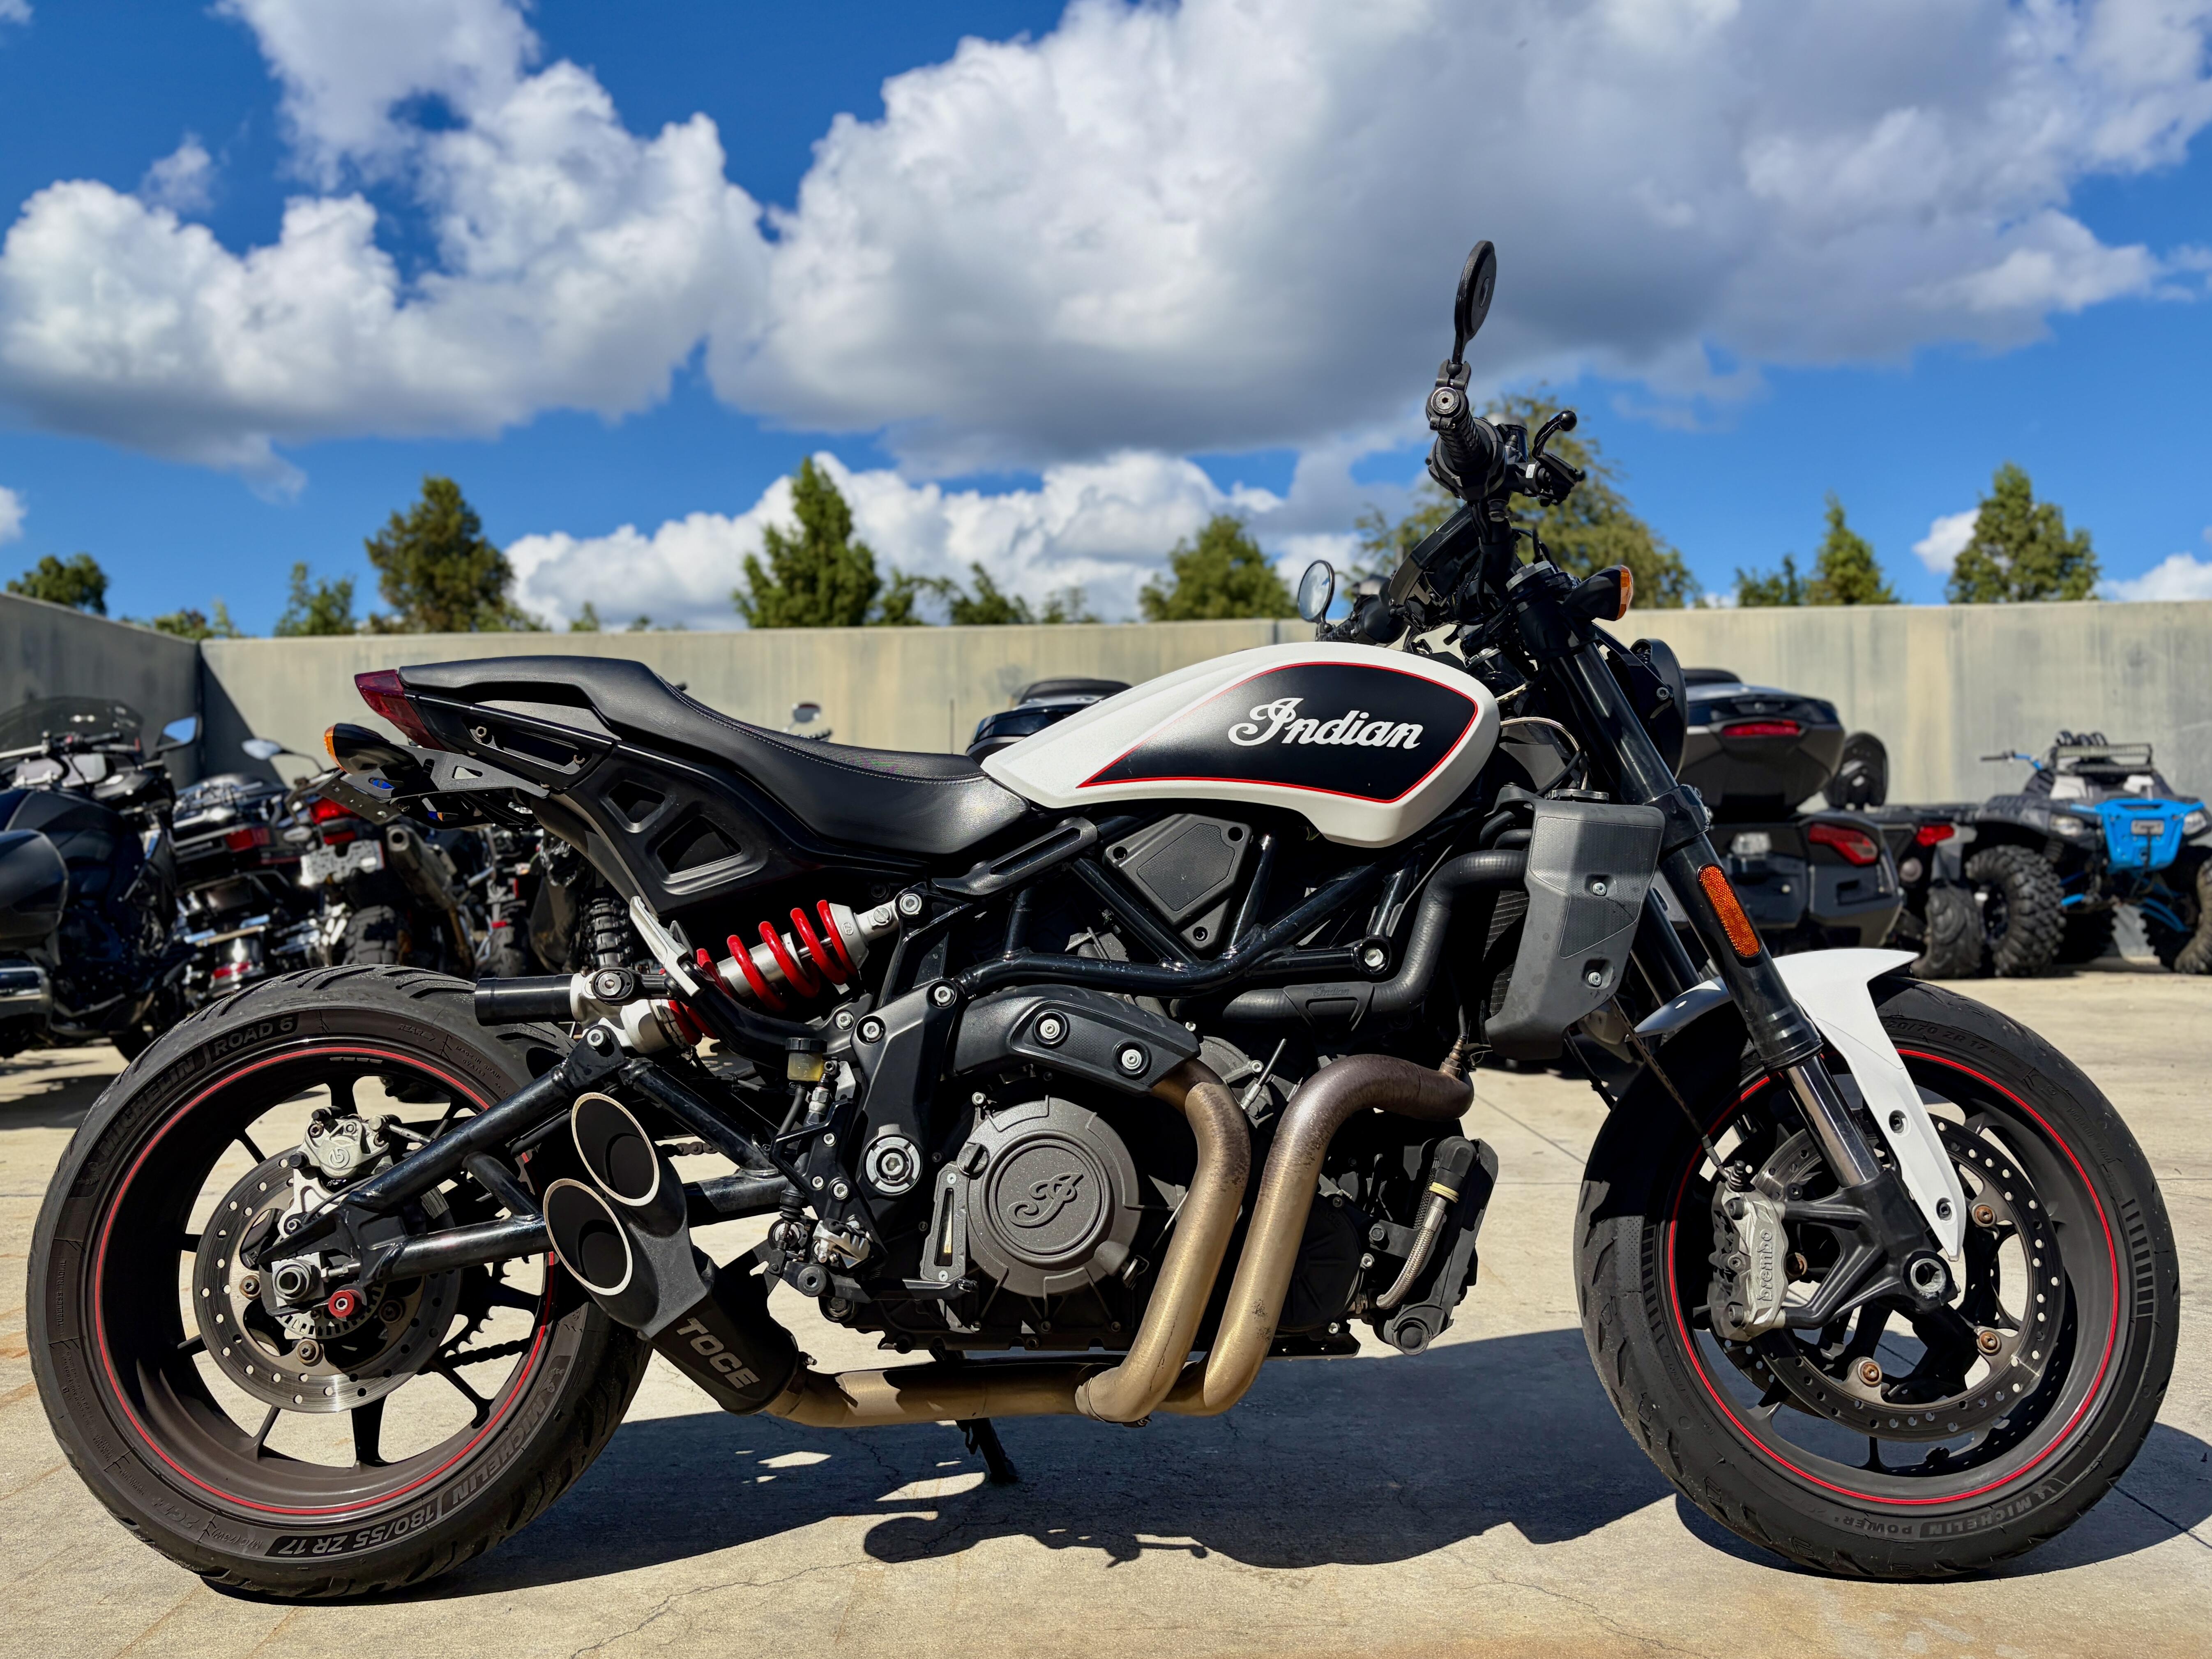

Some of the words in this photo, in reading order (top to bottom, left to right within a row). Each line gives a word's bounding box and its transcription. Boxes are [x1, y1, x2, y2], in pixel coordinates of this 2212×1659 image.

[1228, 697, 1423, 750] Indian
[1313, 986, 1350, 997] Indian
[1942, 1030, 1966, 1042] ZR
[1970, 1041, 1988, 1050] 17
[99, 1056, 195, 1155] MICHELIN
[214, 1023, 273, 1055] ROAD
[280, 1017, 293, 1031] 6
[1756, 1229, 1774, 1302] brembo
[677, 1317, 760, 1389] TOCE
[453, 1394, 547, 1505] MICHELIN
[356, 1505, 435, 1548] 180/55
[1842, 1515, 1913, 1535] POWER
[1929, 1497, 2032, 1535] MICHELIN
[279, 1539, 306, 1555] 17
[313, 1535, 349, 1553] ZR
